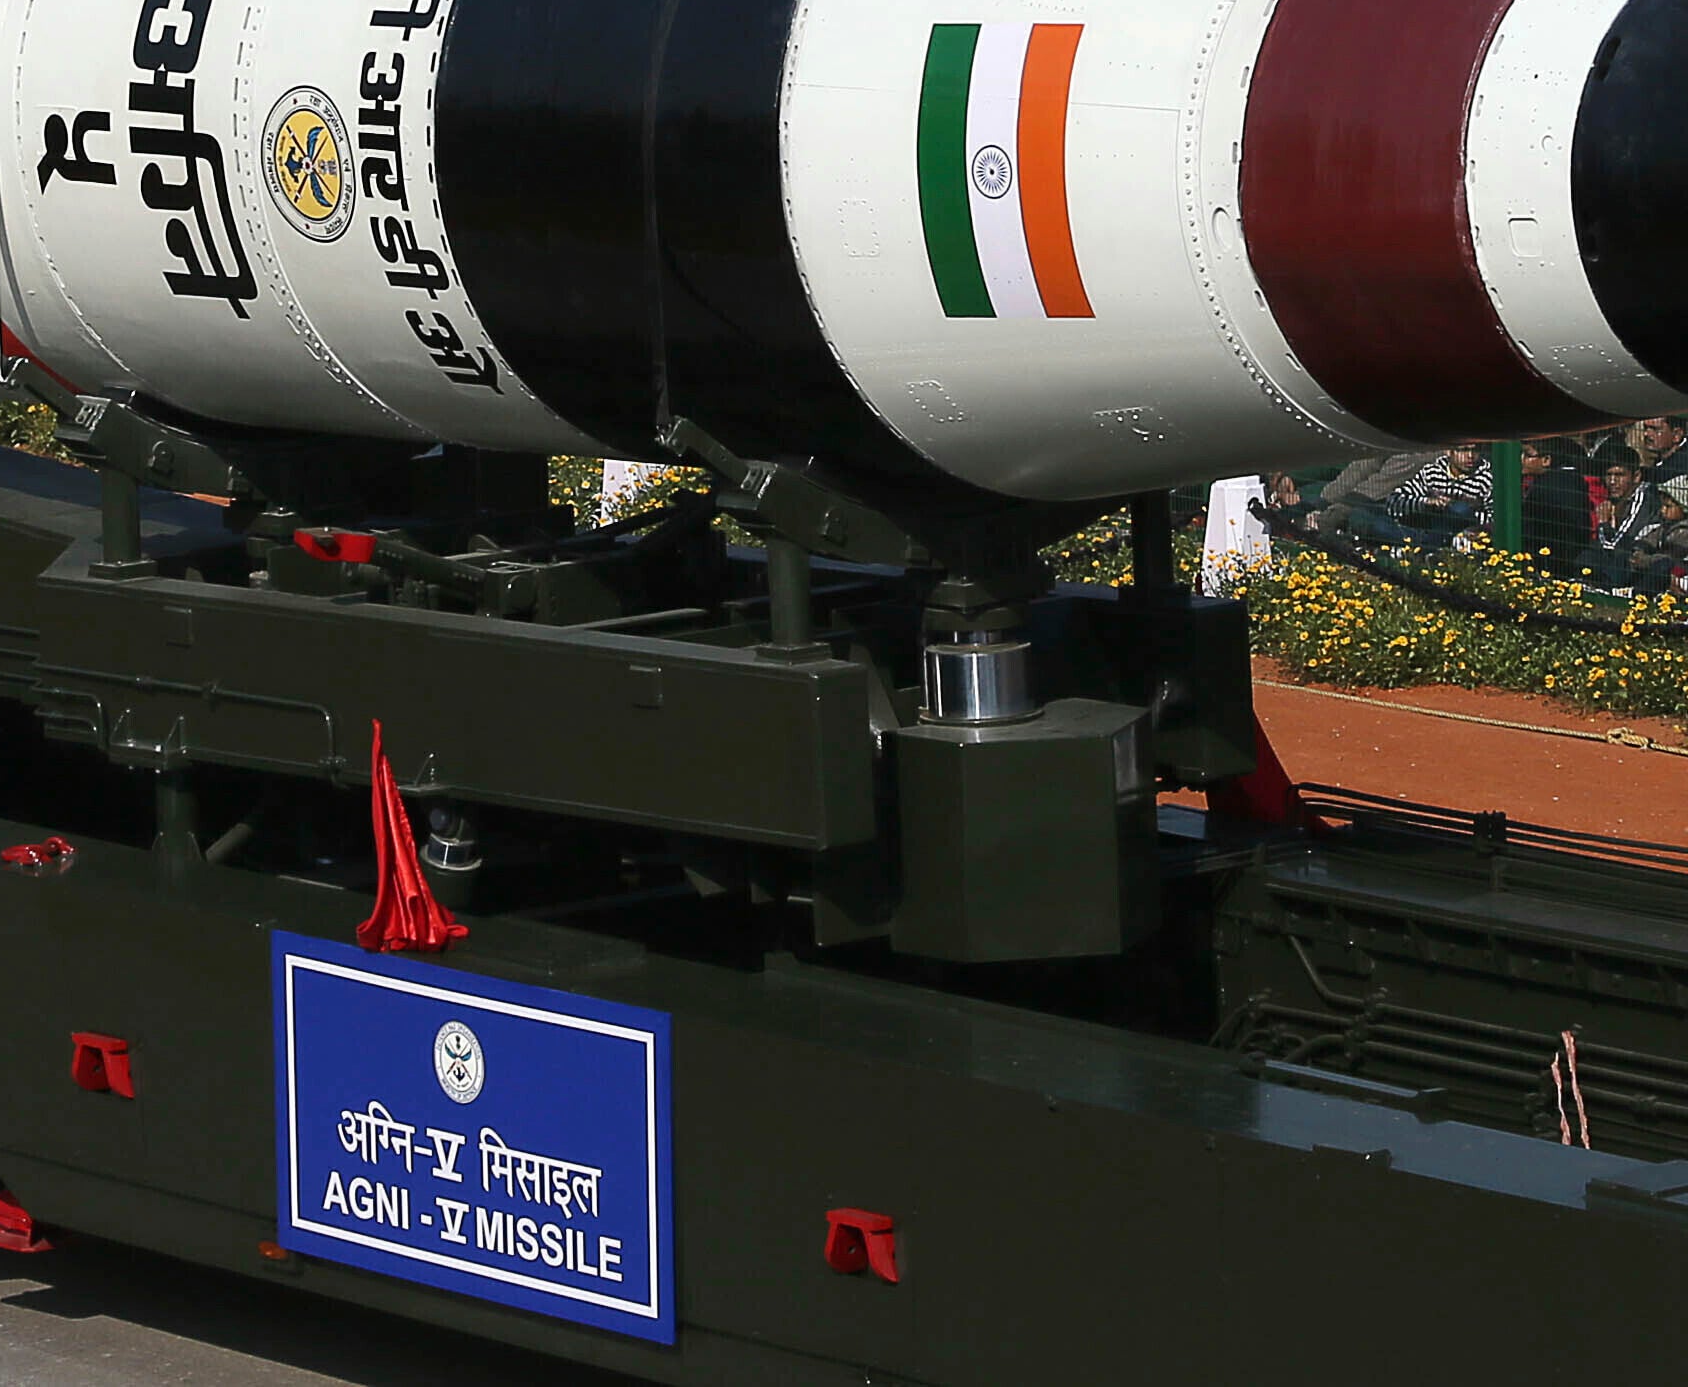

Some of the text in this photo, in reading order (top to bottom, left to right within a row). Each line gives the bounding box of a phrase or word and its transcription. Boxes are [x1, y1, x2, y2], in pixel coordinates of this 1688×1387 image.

[358, 51, 410, 212] आर
[369, 215, 451, 301] डी
[405, 309, 505, 395] ओ
[478, 1128, 602, 1219] मिसाइल
[323, 1172, 409, 1230] AGNI
[476, 1206, 623, 1282] MISSILE
